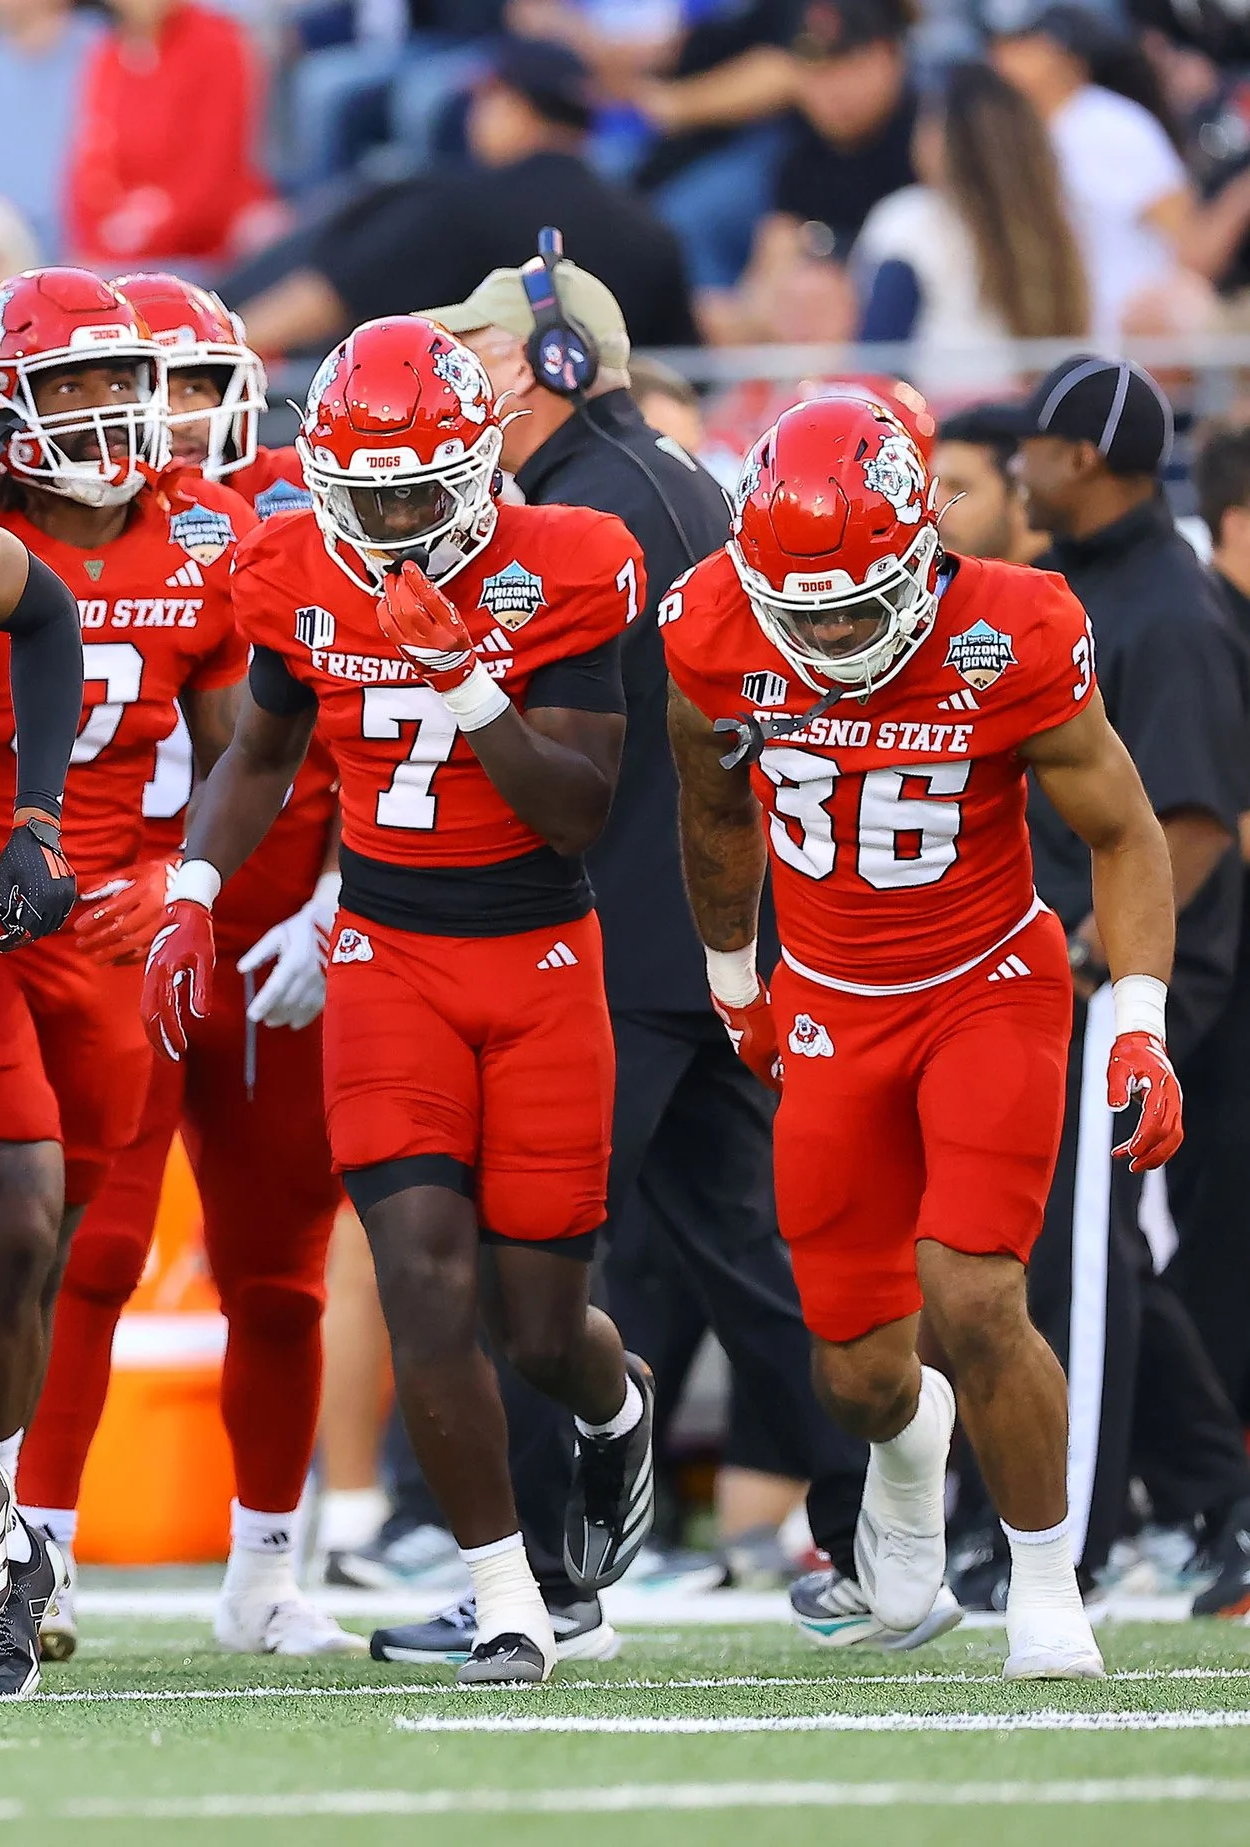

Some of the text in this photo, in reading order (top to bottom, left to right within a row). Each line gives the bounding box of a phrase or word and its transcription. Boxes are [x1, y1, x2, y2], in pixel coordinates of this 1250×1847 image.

[484, 586, 540, 601] ARIZONA
[494, 597, 533, 611] BOWL
[615, 556, 639, 625] 7
[110, 598, 204, 629] STATE
[951, 643, 1009, 660] ARIZONA
[962, 655, 1000, 670] BOWL
[876, 721, 974, 753] STATE
[361, 686, 459, 831] 7
[758, 746, 973, 891] 36
